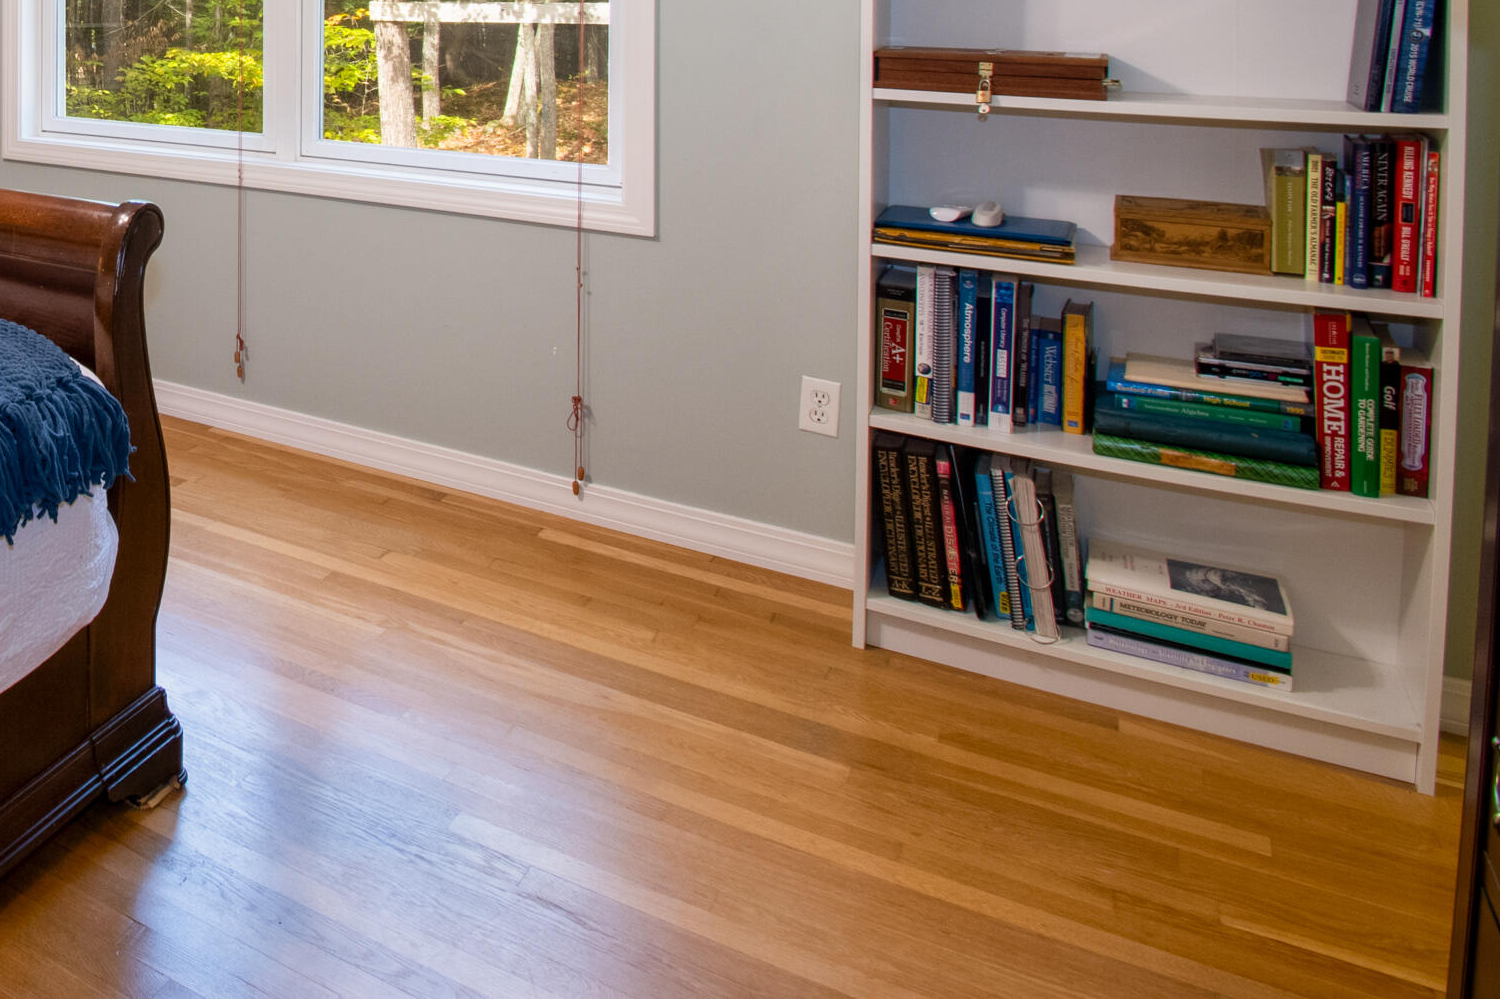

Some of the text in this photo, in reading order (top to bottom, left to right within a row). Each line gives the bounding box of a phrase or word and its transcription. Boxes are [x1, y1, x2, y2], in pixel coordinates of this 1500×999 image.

[1403, 43, 1419, 103] 2015 WORLD CRUISE
[1361, 150, 1370, 190] AMERICA
[1376, 152, 1388, 221] NEVER AGAIN
[1402, 146, 1415, 199] KILLING KENNEDY
[1310, 204, 1318, 235] FARMER'S
[1310, 235, 1318, 266] ALMANAC
[1400, 226, 1411, 261] BILL O'REILLY
[883, 321, 893, 372] Certification
[962, 302, 974, 363] Atmosphere
[999, 307, 1008, 349] Computer Literacy
[1020, 329, 1029, 352] WONDER
[891, 342, 906, 363] A+
[1044, 346, 1057, 383] Webster
[1019, 363, 1027, 387] WEATHER
[1044, 384, 1057, 414] DICTIONARY
[1181, 407, 1210, 417] Algebra
[1203, 395, 1250, 407] High School
[1286, 406, 1305, 414] 1995
[1322, 363, 1345, 435] HOME
[1383, 386, 1396, 410] Golf
[1358, 398, 1366, 452] TO GARDENING
[1366, 398, 1375, 437] COMPLETE
[1412, 393, 1424, 444] FULLY LOADED
[1334, 436, 1345, 478] REPAIR &
[1366, 438, 1375, 461] GUIDE
[1383, 437, 1396, 478] DUMMIES
[889, 451, 909, 577] Reader's Digest ILLUSTRATED
[918, 456, 939, 584] Reader's Digest ILLUSTRATED
[942, 489, 951, 523] NATURAL
[885, 518, 899, 574] DICTIONARY
[915, 524, 928, 581] DICTIONARY
[985, 501, 1003, 584] The Climate of the Earth
[1104, 585, 1142, 600] WEATHER
[1145, 594, 1167, 606] MAPS
[1187, 604, 1213, 617] Edition
[1119, 601, 1207, 628] METEOROLOGY TODAY
[1217, 611, 1246, 624] Peter R.
[1249, 672, 1275, 684] USED
